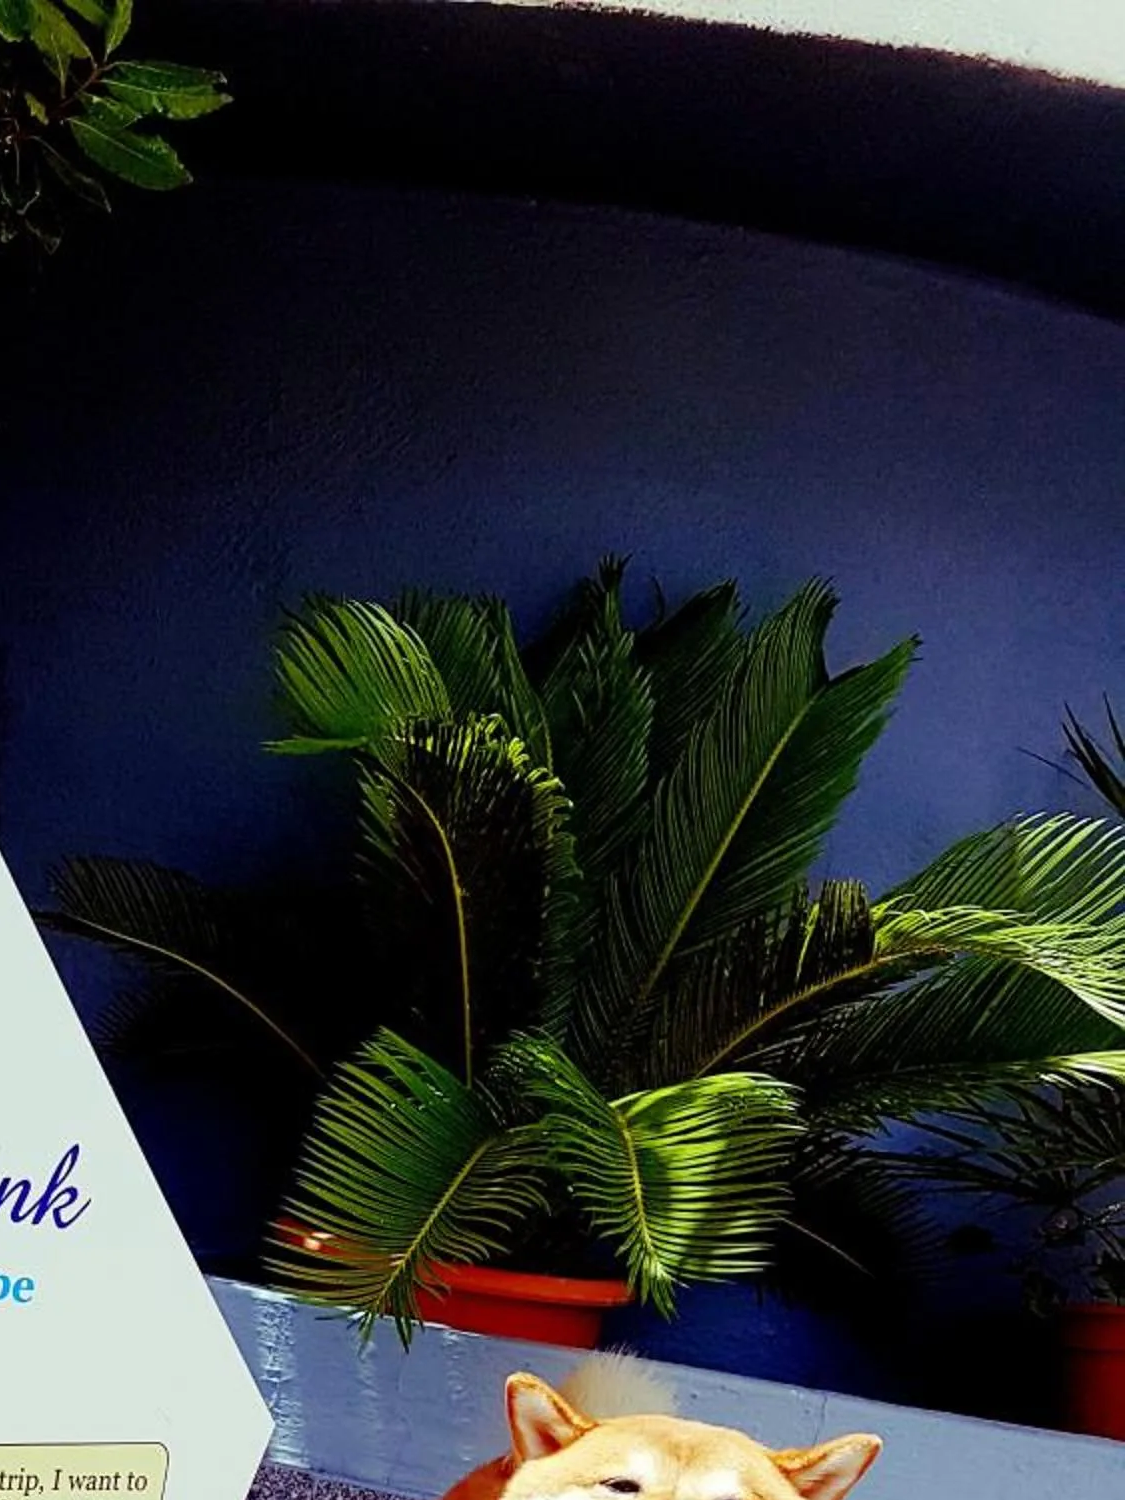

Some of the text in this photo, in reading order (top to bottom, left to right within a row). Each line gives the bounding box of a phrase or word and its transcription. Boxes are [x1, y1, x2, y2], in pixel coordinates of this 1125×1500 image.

[51, 1469, 62, 1491] I
[68, 1472, 121, 1491] want
[126, 1472, 148, 1491] to
